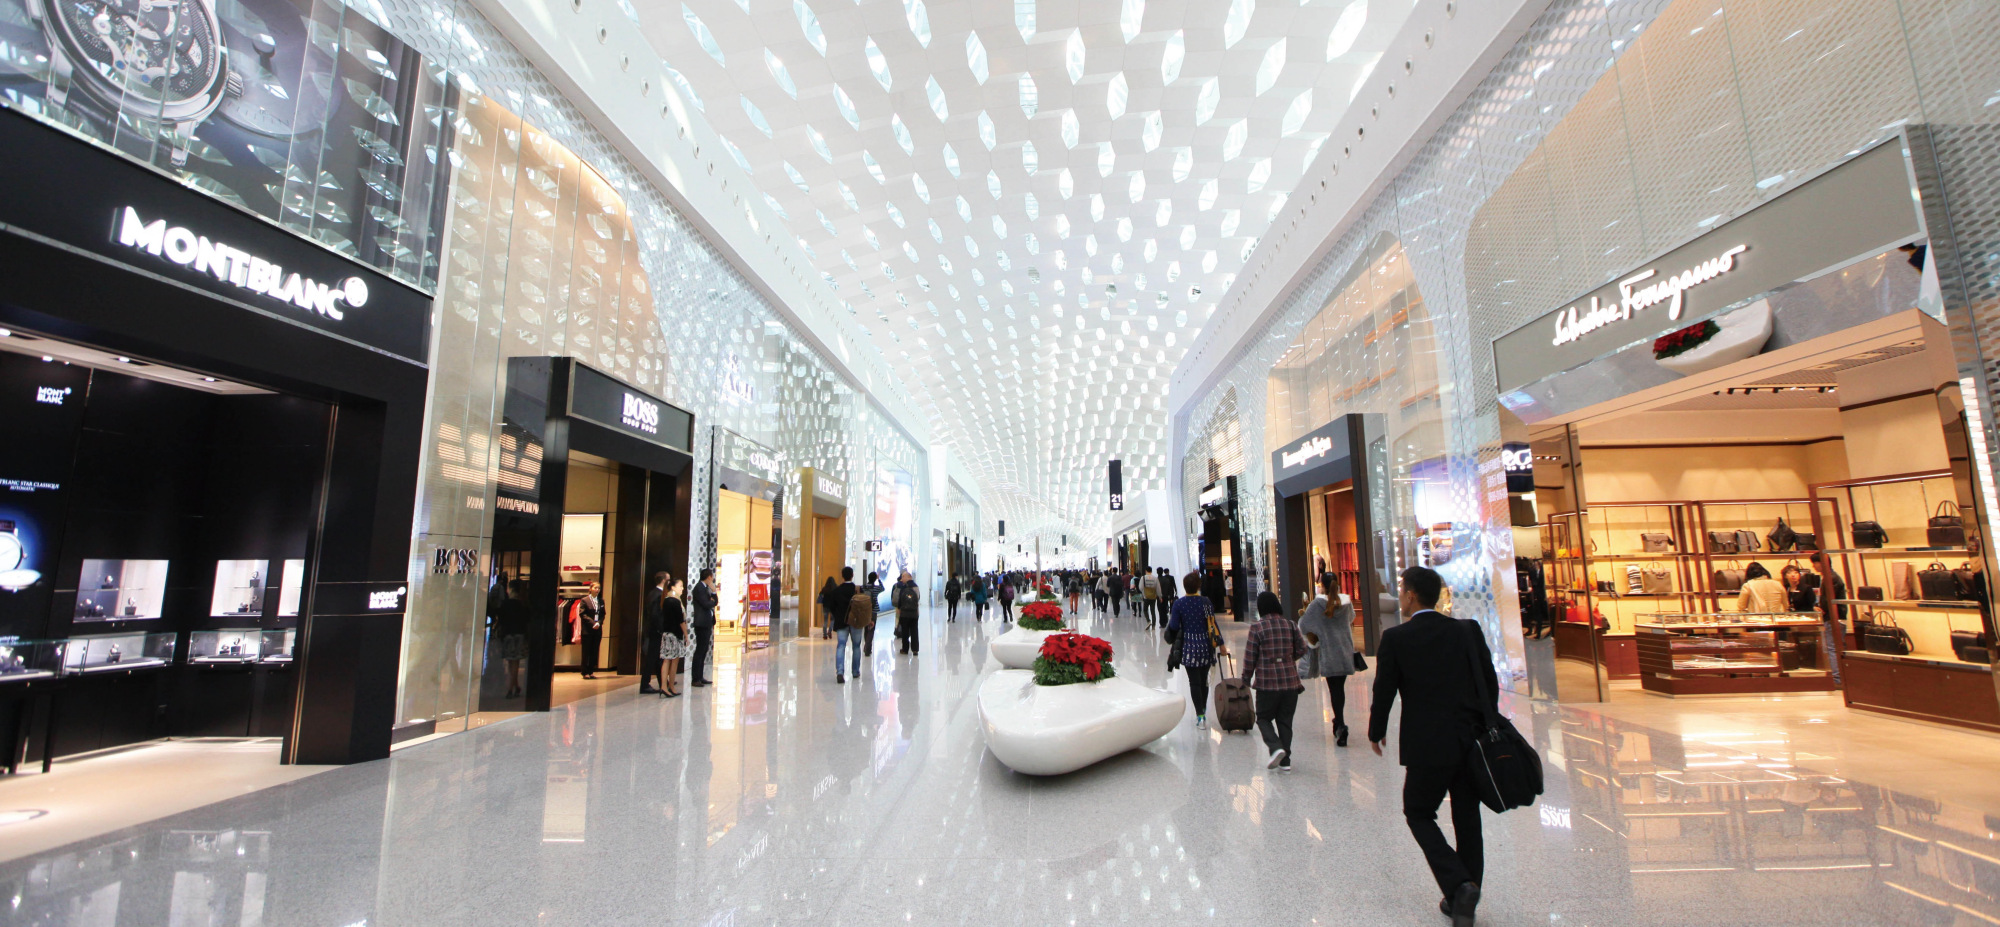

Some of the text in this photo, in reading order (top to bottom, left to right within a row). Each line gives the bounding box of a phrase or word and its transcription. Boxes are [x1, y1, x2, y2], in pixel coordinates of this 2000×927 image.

[119, 206, 345, 320] MONTBLANC
[1618, 244, 1747, 321] Ferragamo
[37, 394, 63, 404] BLANC
[38, 386, 64, 397] MONT
[622, 392, 658, 427] BOSS
[818, 476, 843, 499] VERSACE
[1111, 493, 1122, 503] 21
[433, 547, 479, 567] BOSS
